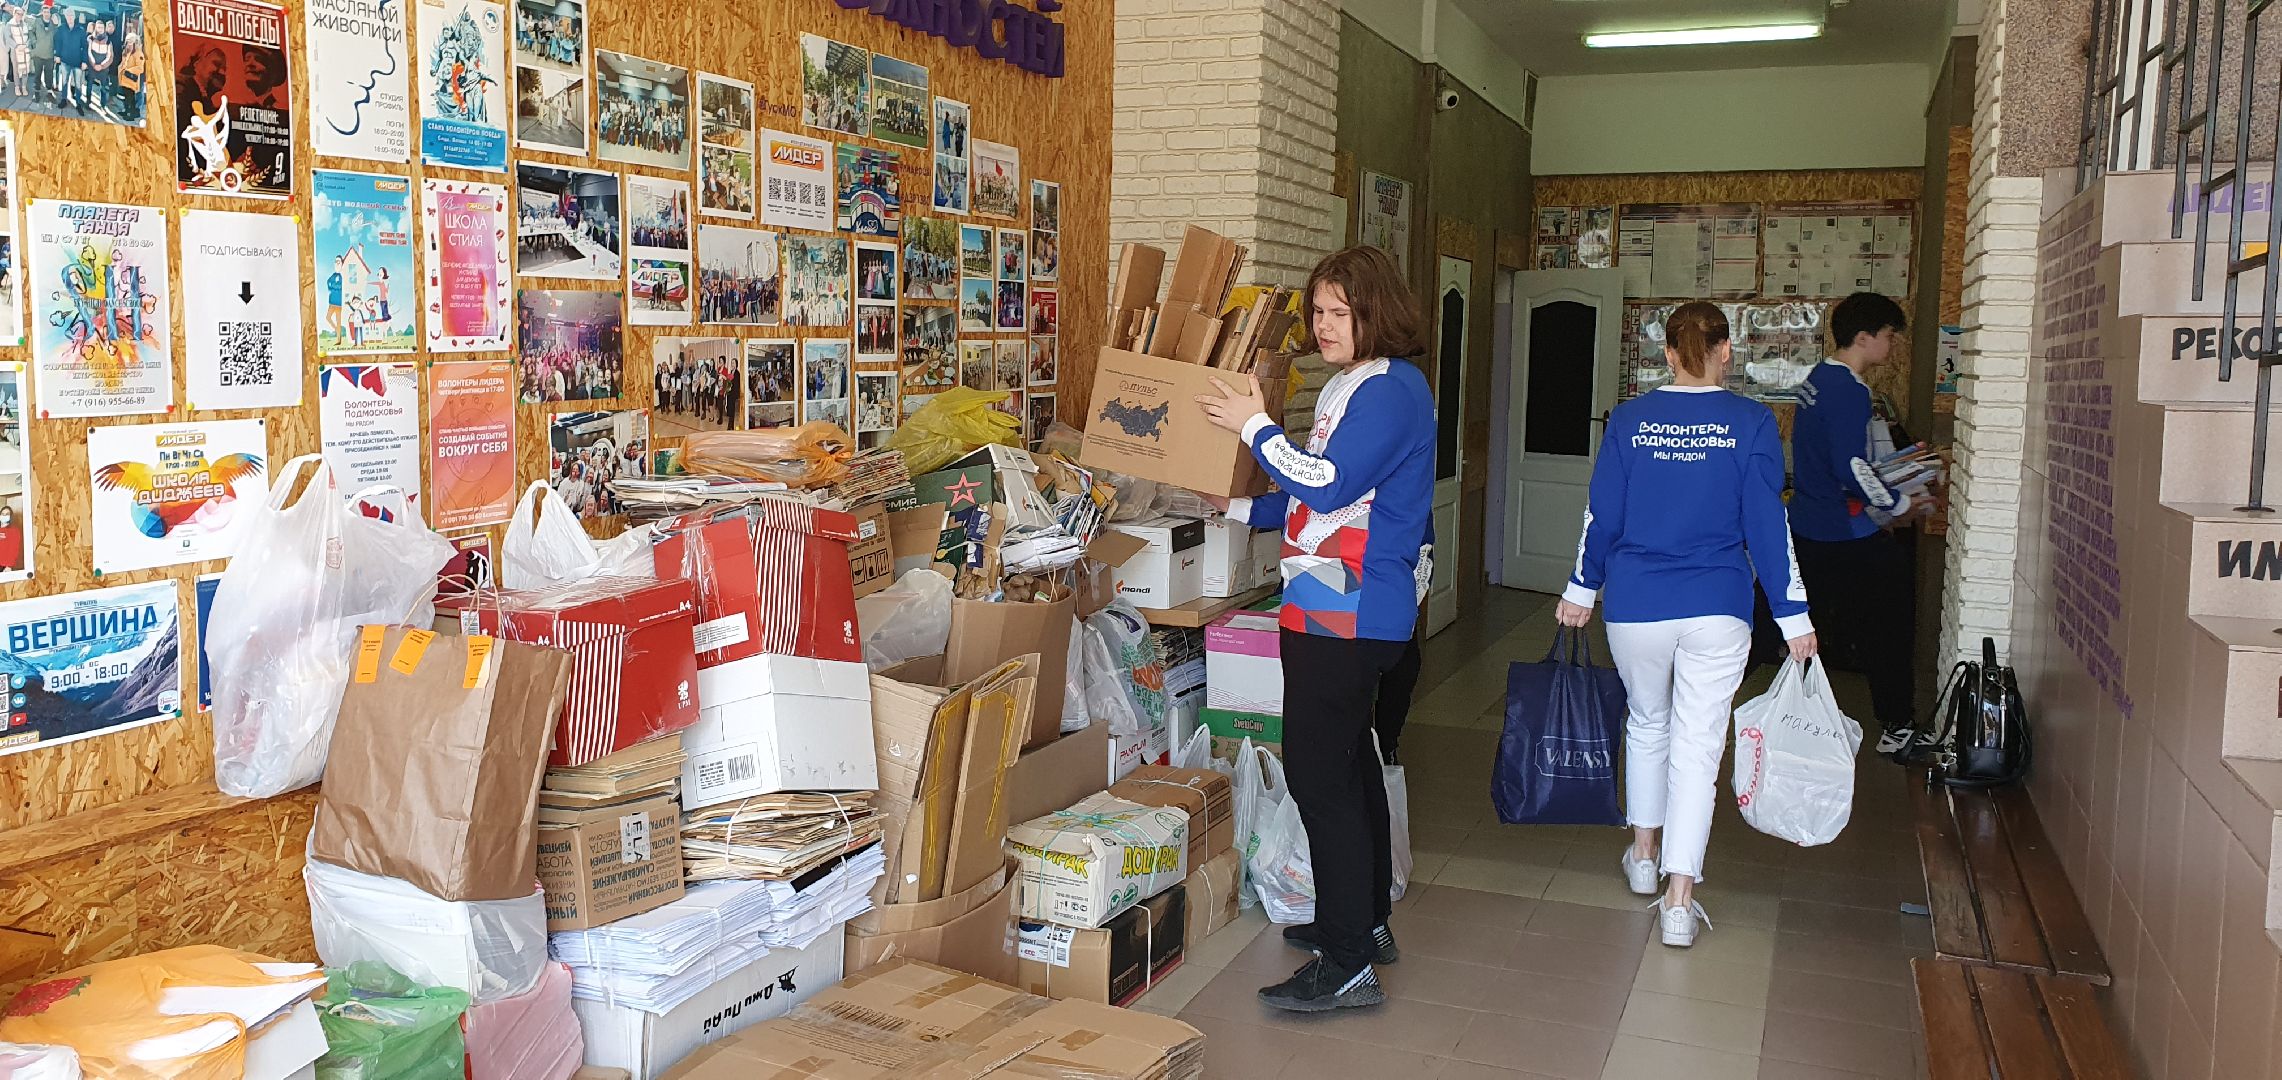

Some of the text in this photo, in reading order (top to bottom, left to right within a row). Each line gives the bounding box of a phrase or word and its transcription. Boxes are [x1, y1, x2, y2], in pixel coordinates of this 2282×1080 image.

[312, 0, 399, 24] МАСЛЯНОЙ
[177, 2, 224, 34] ВАЛЬС
[227, 10, 280, 45] ПОБЕДЫ
[313, 11, 402, 44] ЖИВОПИСИ
[275, 152, 284, 174] 9
[773, 146, 822, 165] ЛИДЕР
[58, 204, 139, 222] ПЛАНЕТА
[73, 220, 130, 237] ТАНЦА
[444, 213, 487, 230] ШКОЛА
[449, 232, 483, 247] СТИЛЯ
[200, 245, 283, 258] ПОДПИСЫВАЙСЯ
[438, 379, 478, 388] ВОЛОНТЕРЫ
[1129, 383, 1158, 395] ПУЛЬС
[345, 400, 393, 409] ВОЛОНТЕРЫ
[345, 408, 403, 418] ПОДМОСКОВЬЯ
[1639, 421, 1729, 436] ВОЛОНТЕРЫ
[159, 434, 204, 445] ЛИДЕР
[438, 431, 507, 444] СОЗДАВАЙ СОБЫТИЯ
[1632, 435, 1736, 449] ПОДМОСКОВЬЯ
[438, 441, 507, 458] ВОКРУГ СЕБЯ
[1653, 450, 1706, 462] МЫ РЯДОМ
[152, 471, 210, 489] ШКОЛА
[138, 484, 225, 505] ДИДЖЕЕВ
[886, 497, 917, 511] РМИЯ
[1122, 586, 1150, 594] mondi
[679, 600, 692, 611] A4
[8, 605, 158, 654] ВЕРШИНА
[537, 635, 549, 645] A4
[51, 672, 81, 689] 9:00
[95, 663, 128, 680] 18:00
[1233, 717, 1264, 732] SvetoCopy
[1119, 738, 1147, 761] PANTUM
[650, 815, 675, 832] НАТУРА
[538, 840, 571, 854] ВЕЦИЕЙ
[537, 856, 573, 868] АБОТА
[1121, 843, 1182, 879] ДОШИРАК
